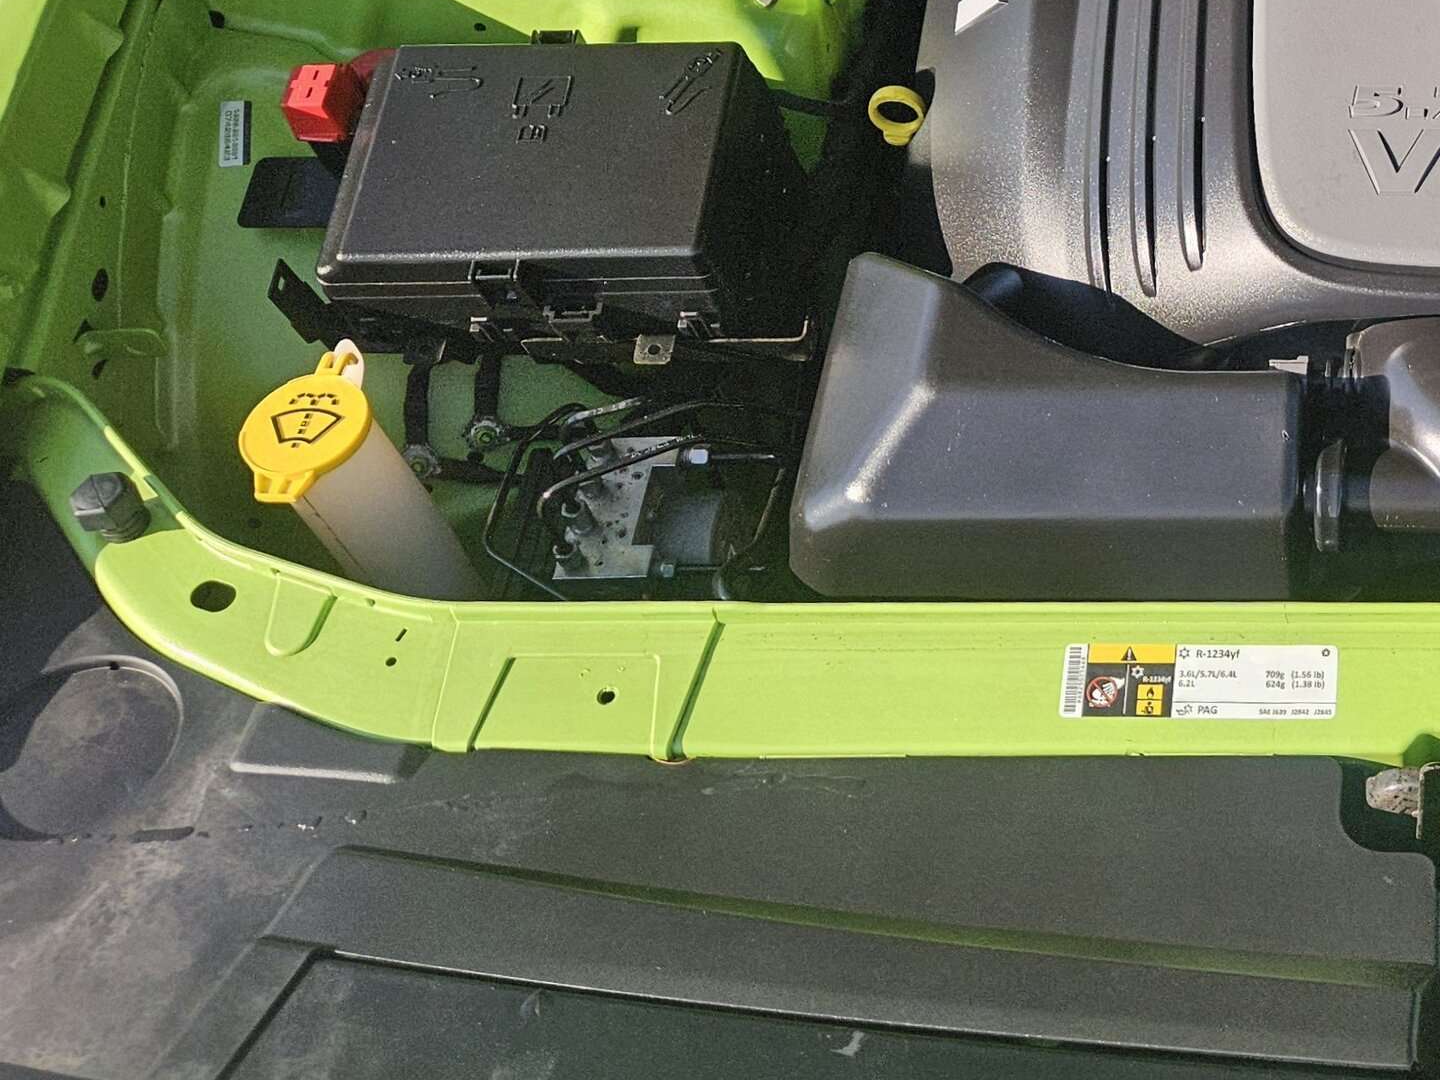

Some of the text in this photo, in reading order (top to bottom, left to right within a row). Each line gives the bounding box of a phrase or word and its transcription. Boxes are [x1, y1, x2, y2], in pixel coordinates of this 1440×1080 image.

[1196, 649, 1240, 660] R-1234yf
[1180, 670, 1237, 679] 3.6L/5.7L/6.4L
[1266, 670, 1325, 679] 709g (1.56 lb)
[1266, 680, 1325, 689] 624g (1.38 lb)
[1197, 706, 1218, 715] PAG
